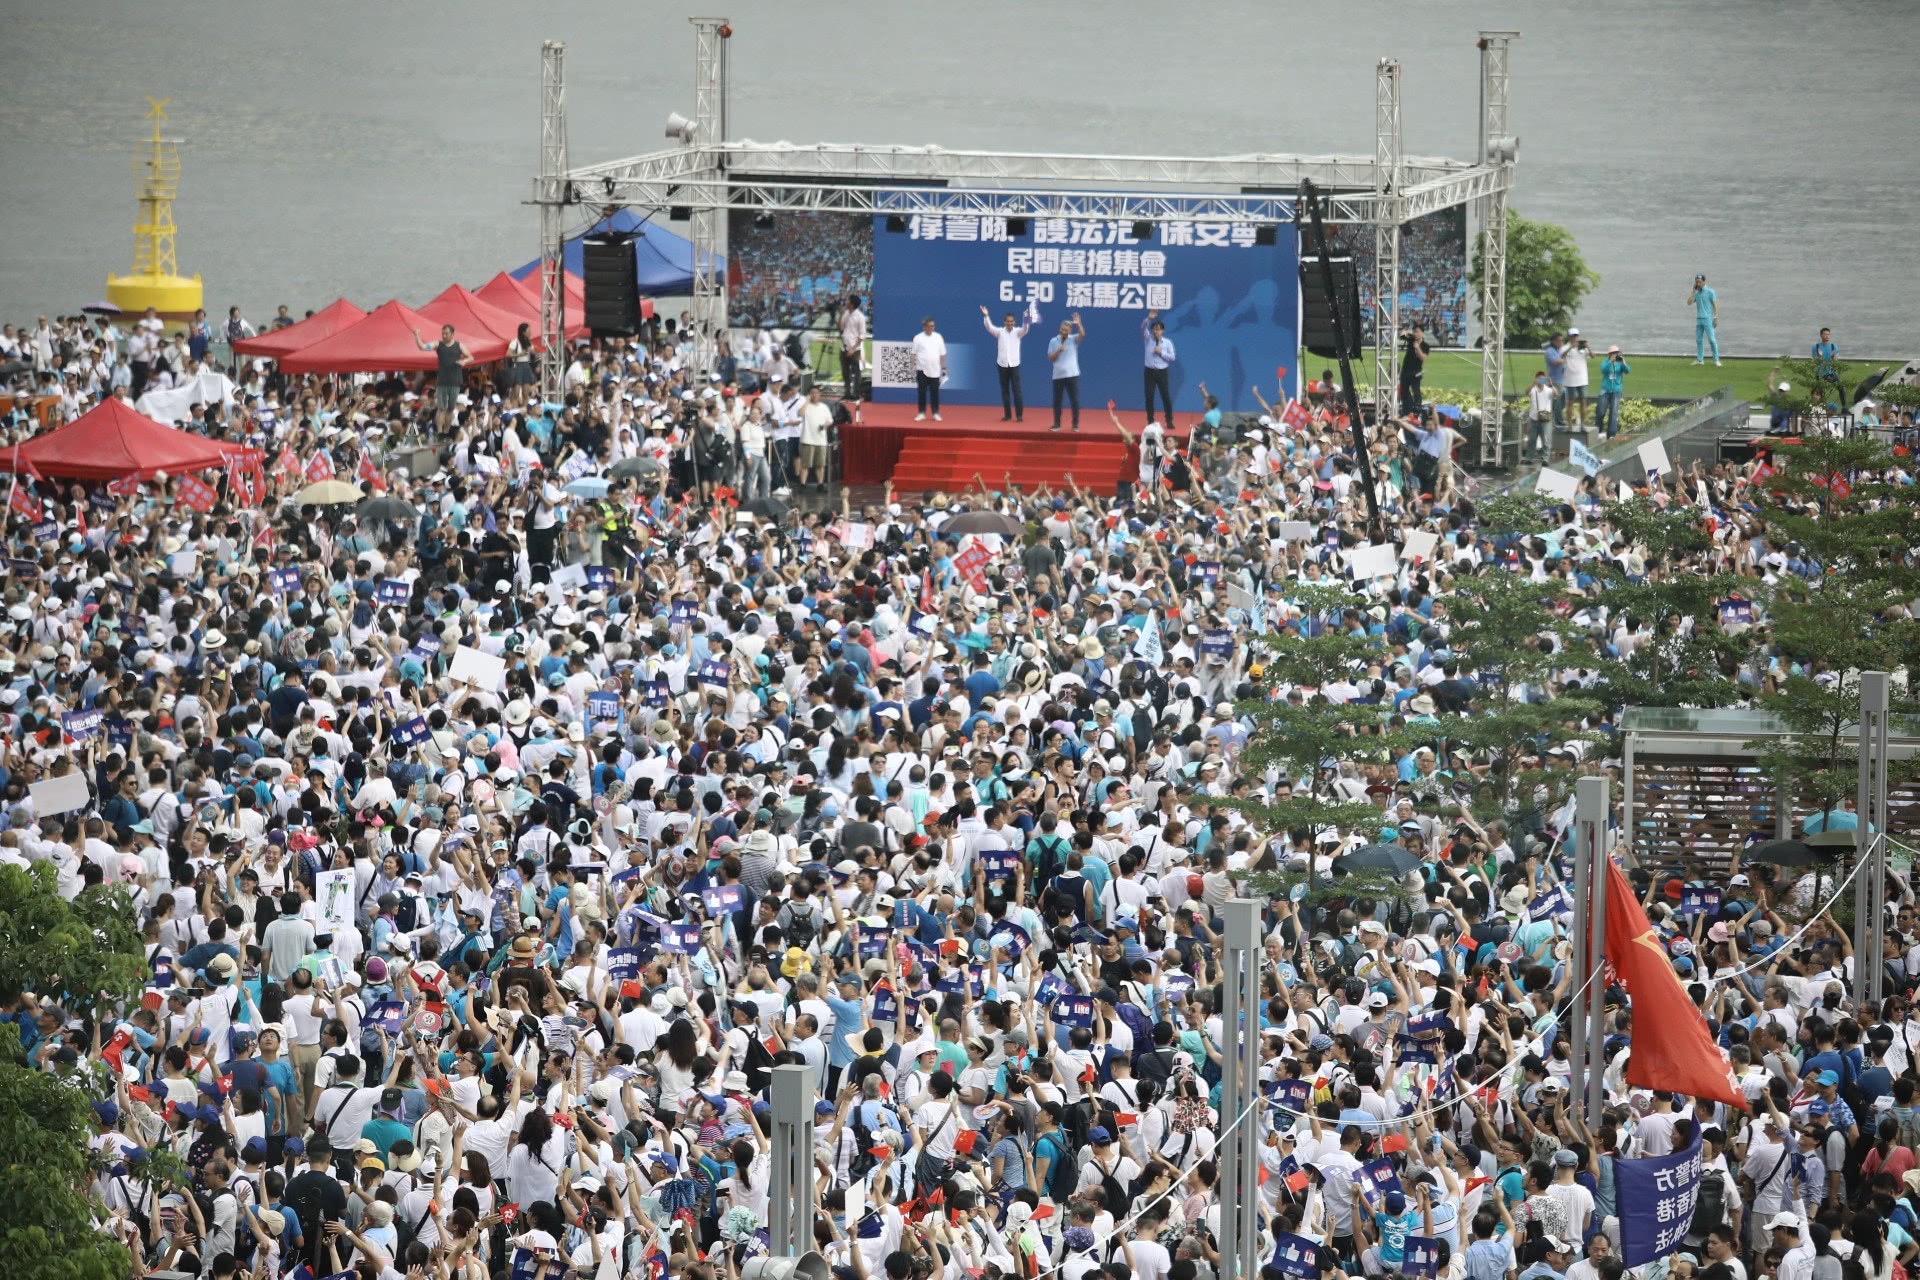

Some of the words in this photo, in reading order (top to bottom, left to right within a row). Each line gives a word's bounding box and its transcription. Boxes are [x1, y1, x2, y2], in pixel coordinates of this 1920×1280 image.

[1008, 248, 1167, 277] 民間聲援集會
[1000, 280, 1054, 303] 6.30
[1066, 282, 1172, 310] 添馬公園
[384, 1008, 399, 1019] Like
[1074, 1003, 1090, 1015] Like
[1291, 1088, 1306, 1100] Like
[1374, 1170, 1393, 1182] Like
